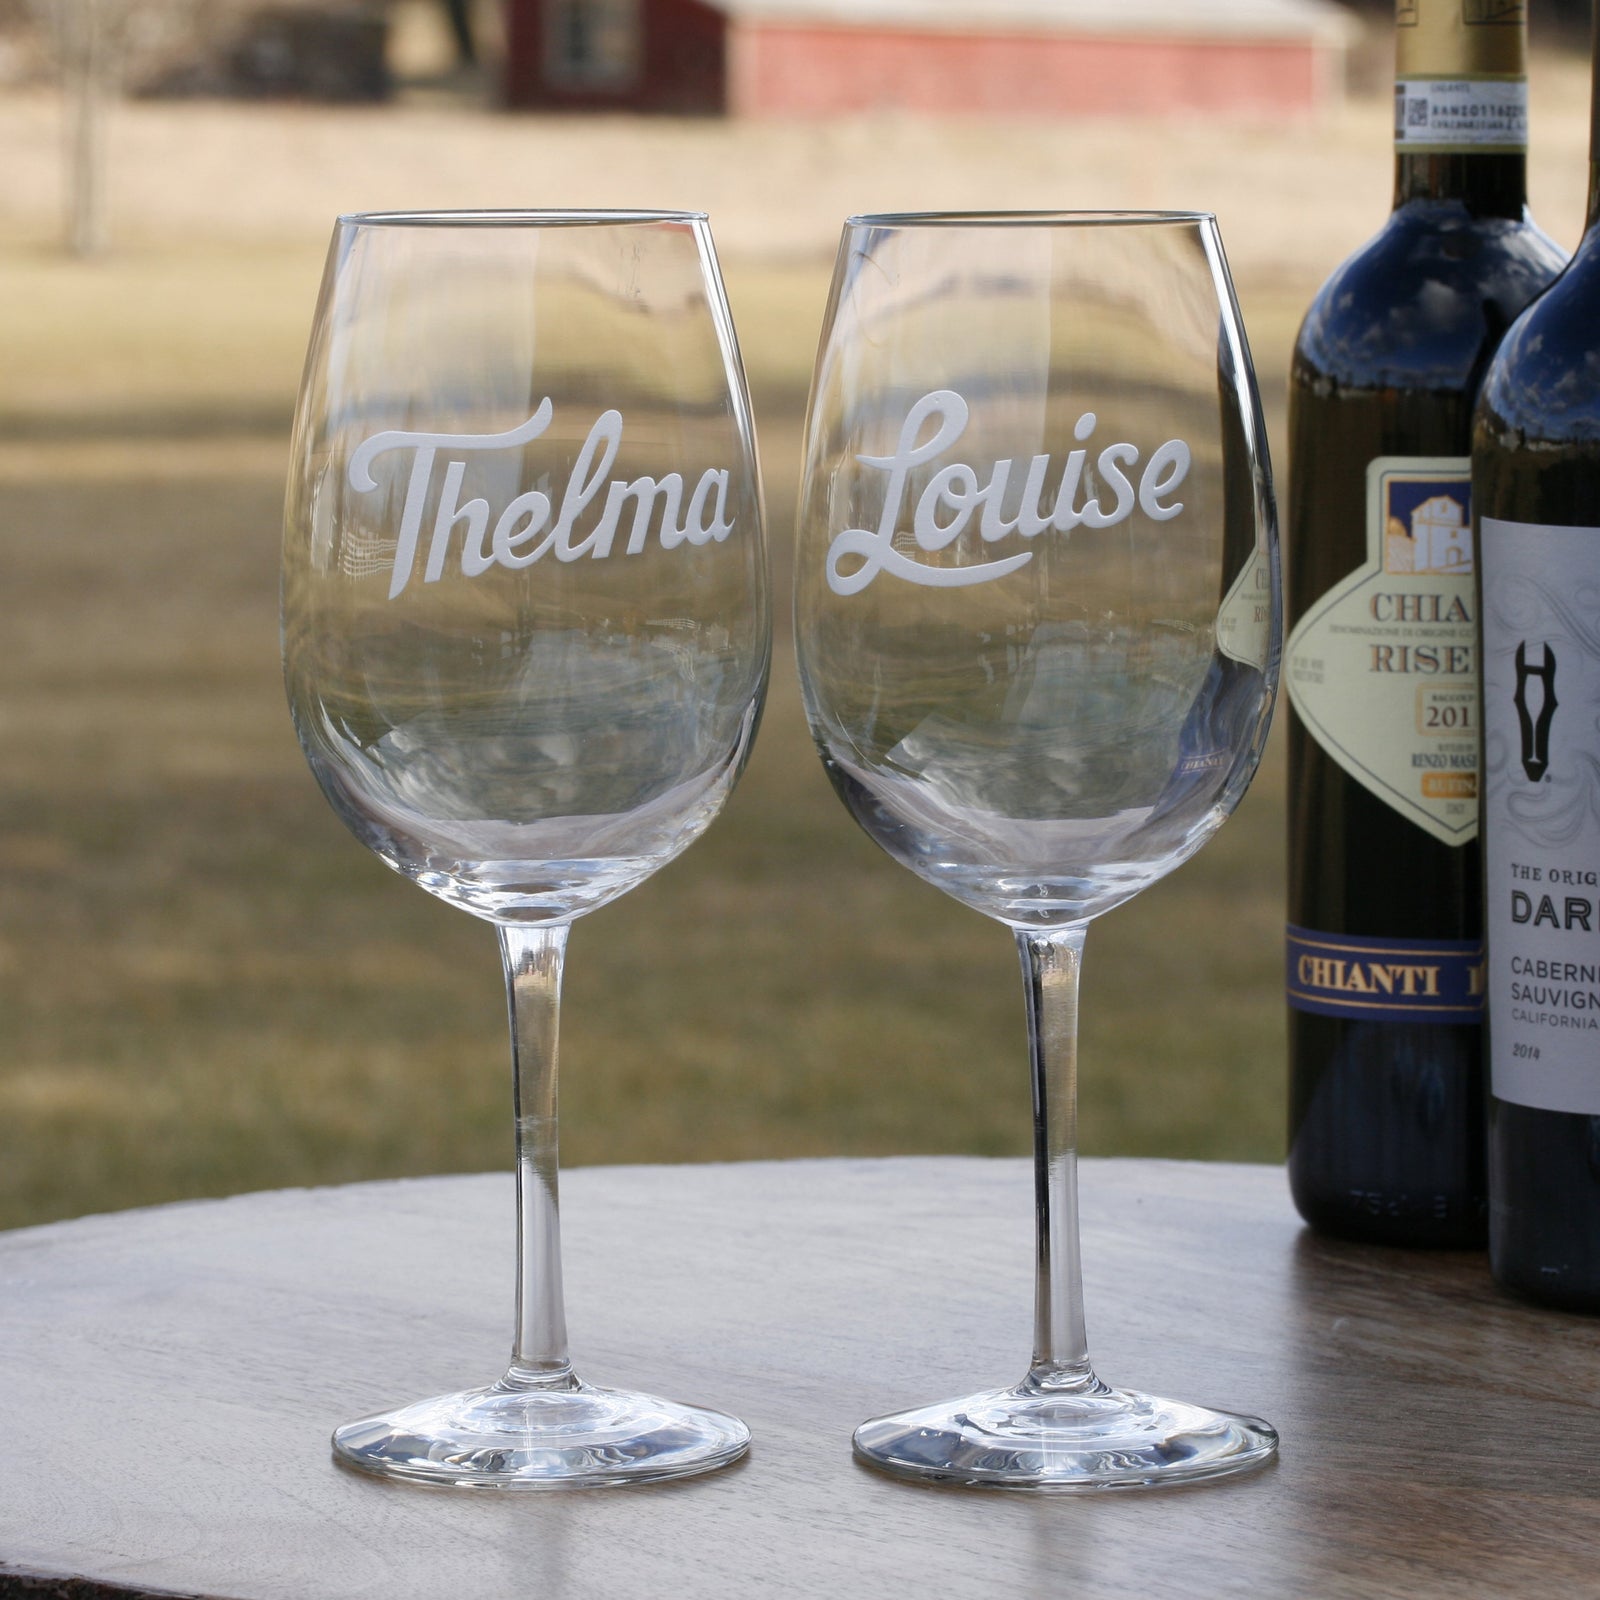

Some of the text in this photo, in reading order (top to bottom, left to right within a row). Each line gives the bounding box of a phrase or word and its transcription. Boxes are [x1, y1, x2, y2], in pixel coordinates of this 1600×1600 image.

[347, 396, 736, 601] Thelma
[825, 389, 1192, 597] Louise
[1370, 592, 1473, 623] CHIA
[1368, 643, 1471, 675] RISE
[1426, 705, 1470, 728] 201
[1510, 862, 1599, 888] THE ORIG
[1510, 889, 1600, 932] DAR
[1297, 953, 1441, 997] CHIANTI
[1511, 955, 1600, 984] CABERN
[1511, 982, 1600, 1010] SAUVIGN
[1511, 1007, 1599, 1031] CALIFORNIA
[1512, 1042, 1541, 1061] 2014
